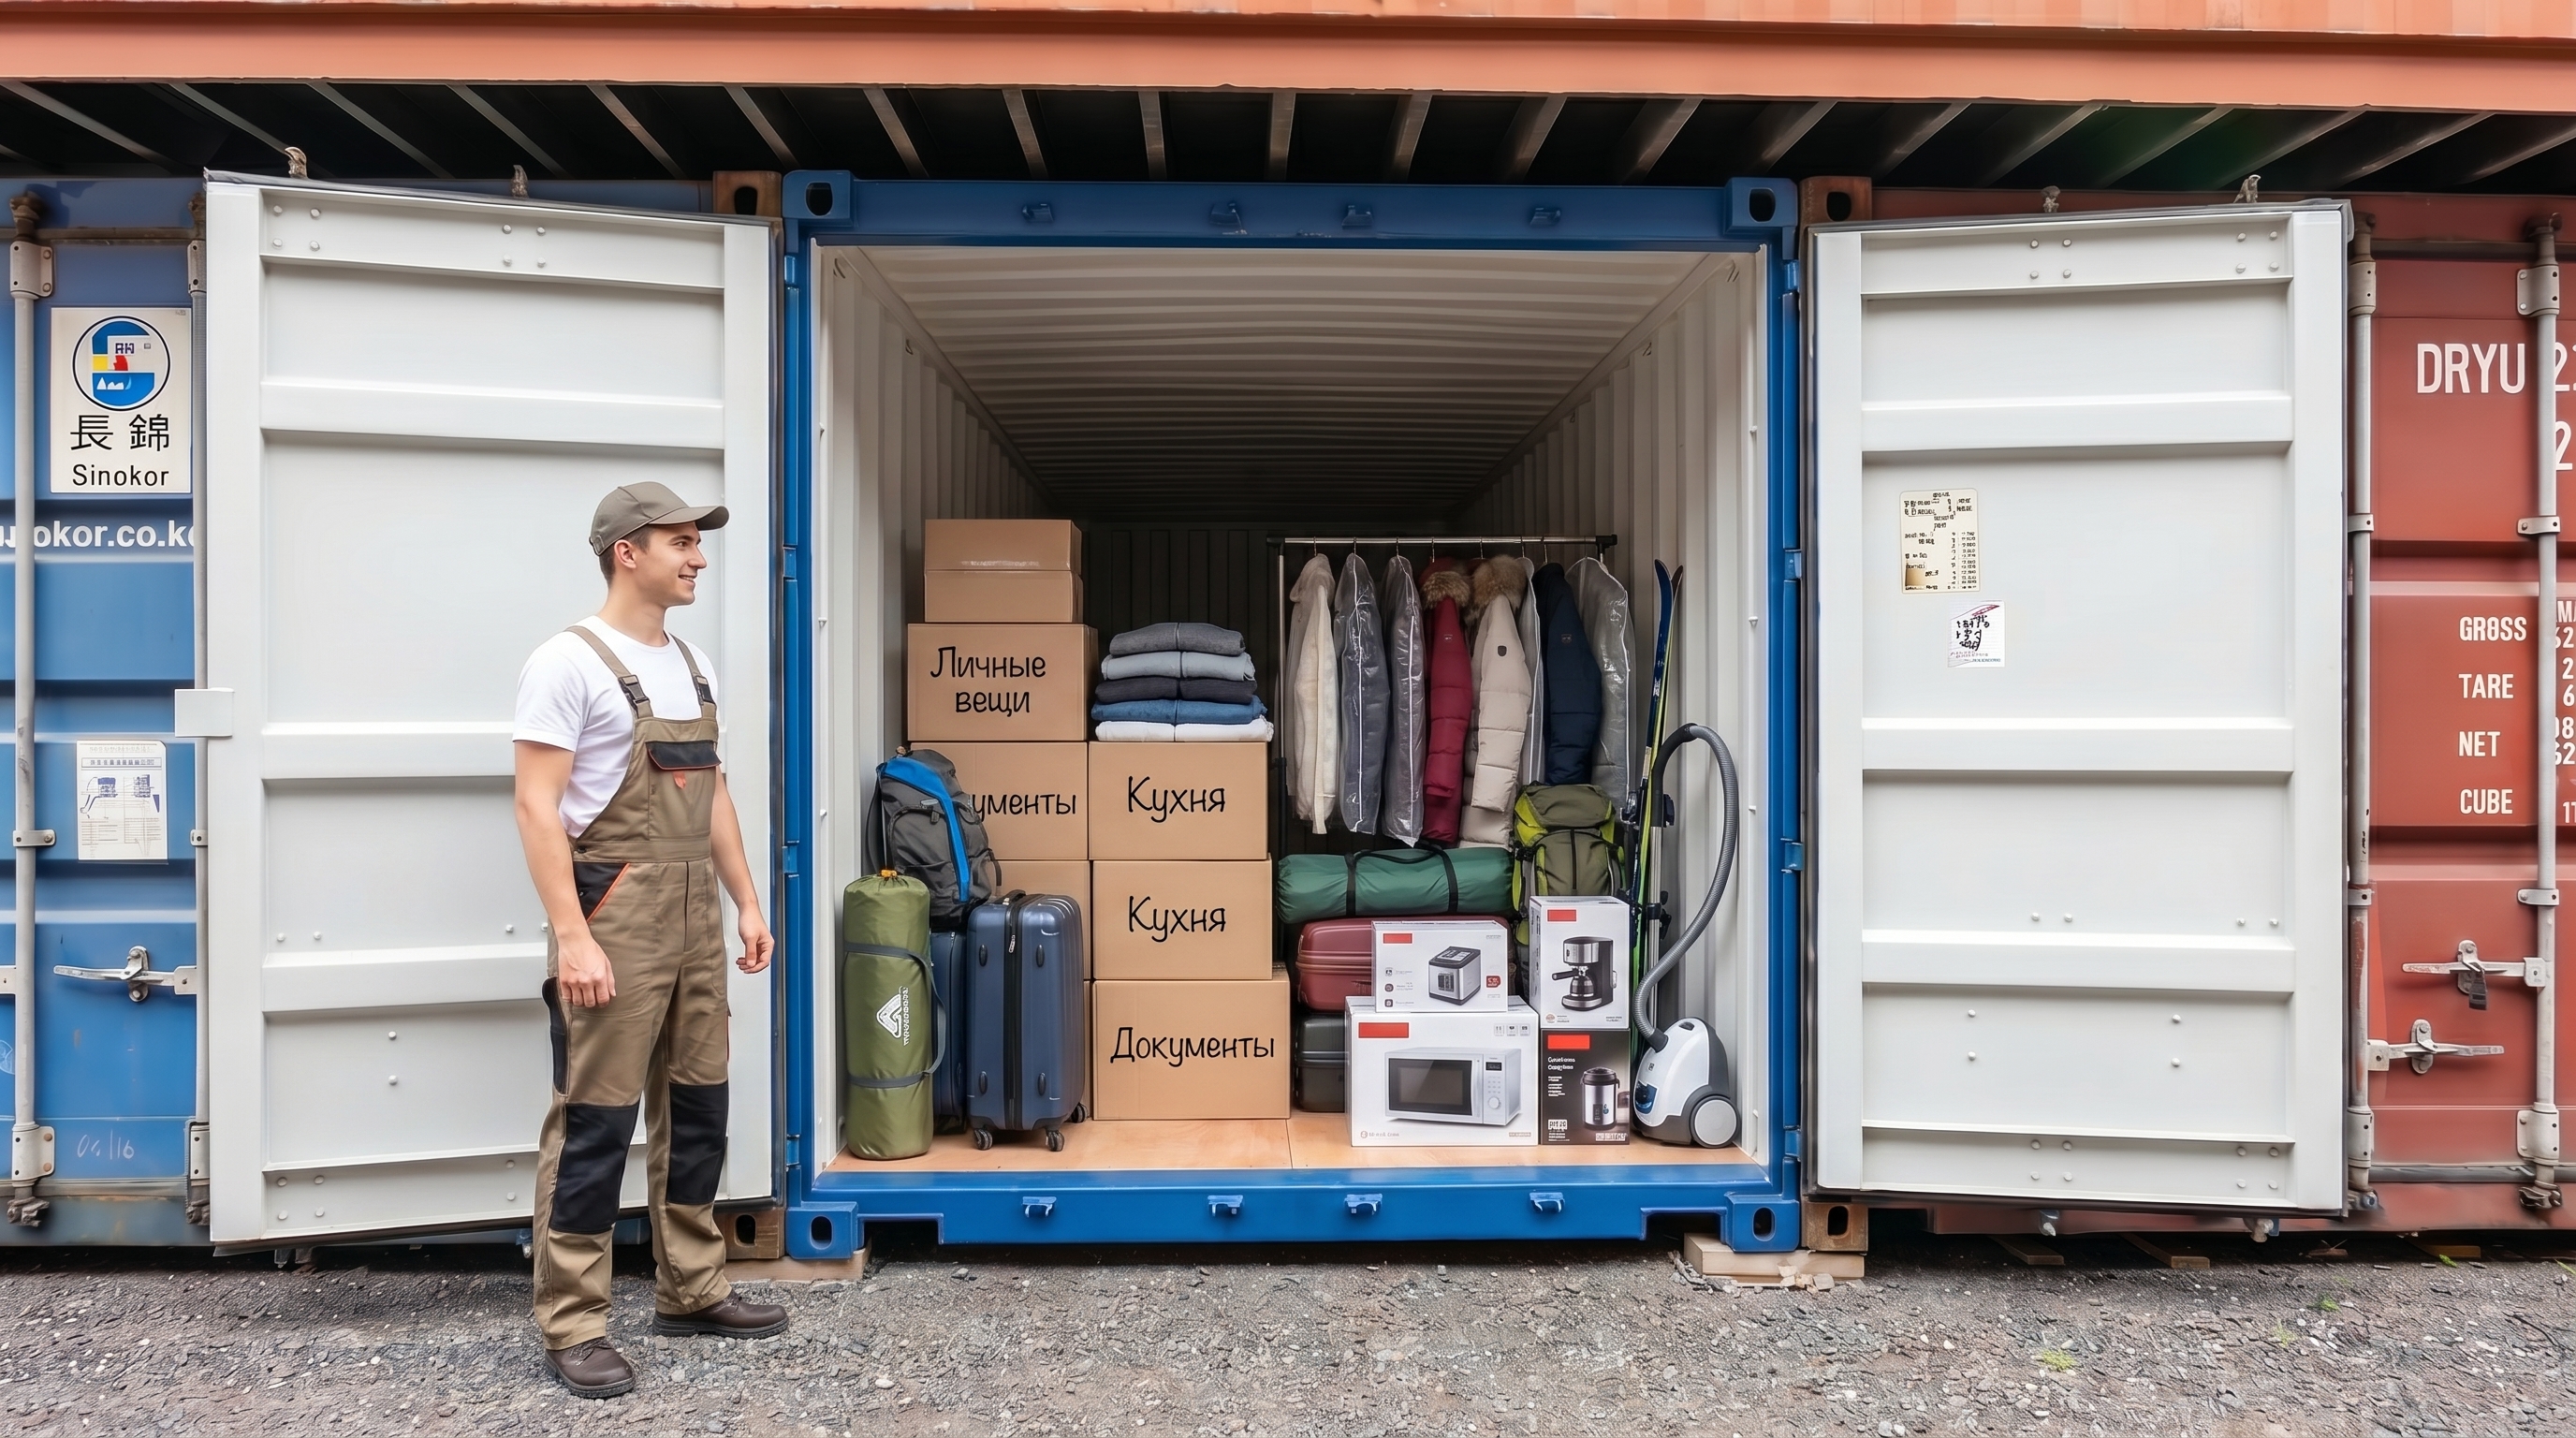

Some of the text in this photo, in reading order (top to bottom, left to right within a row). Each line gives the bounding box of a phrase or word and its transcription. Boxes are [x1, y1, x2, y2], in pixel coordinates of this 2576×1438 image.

[2417, 342, 2576, 394] DRYU 2
[72, 463, 169, 487] Sinokor
[929, 646, 1046, 679] Личные
[2458, 674, 2514, 698] TARE
[955, 691, 1031, 718] вещи
[2459, 731, 2500, 756] NET
[972, 794, 1076, 822] ументы
[1128, 775, 1225, 823] Кухня
[2460, 789, 2513, 814] CUBE
[1129, 895, 1226, 943] Кухня
[1110, 1026, 1275, 1068] Документы
